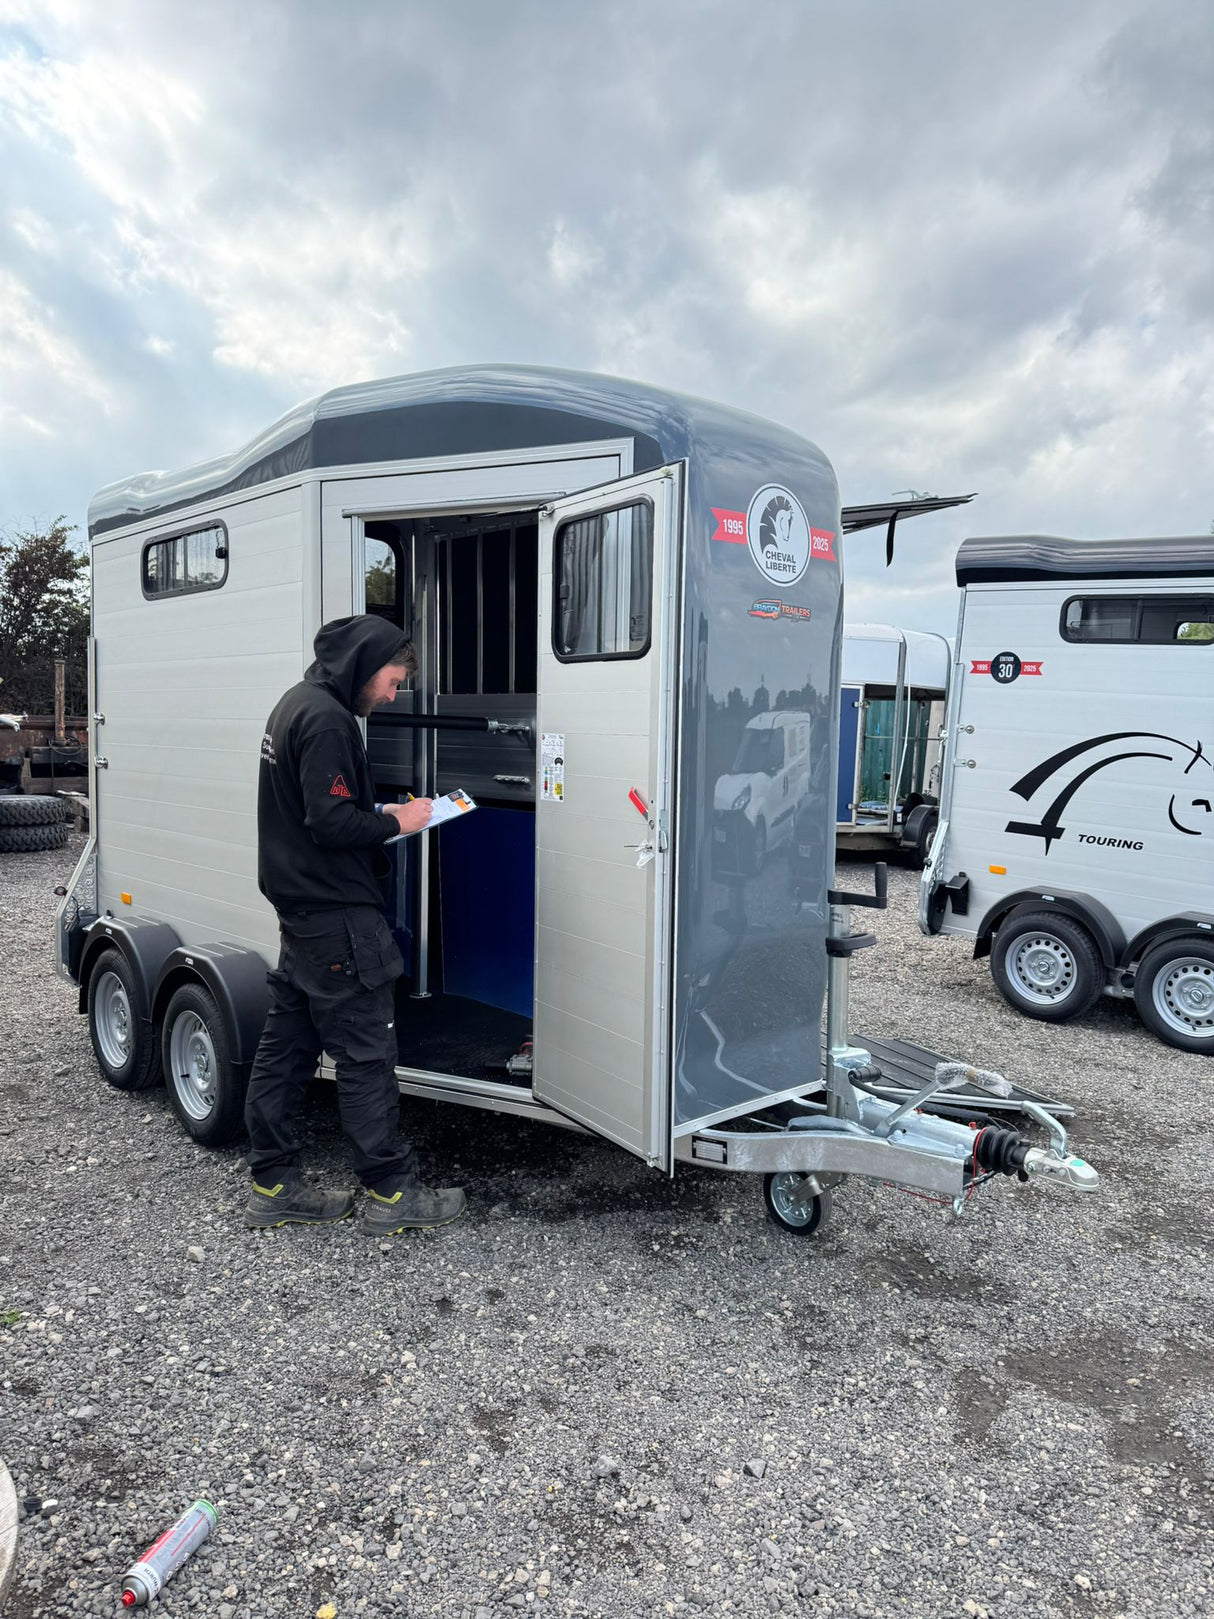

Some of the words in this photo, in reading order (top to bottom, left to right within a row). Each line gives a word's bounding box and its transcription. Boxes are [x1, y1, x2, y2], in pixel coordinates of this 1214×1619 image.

[723, 519, 744, 535] 1995
[812, 536, 829, 552] 2025
[765, 550, 796, 564] CHEVAL
[782, 605, 810, 616] TRAILERS
[1078, 834, 1144, 850] TOURING
